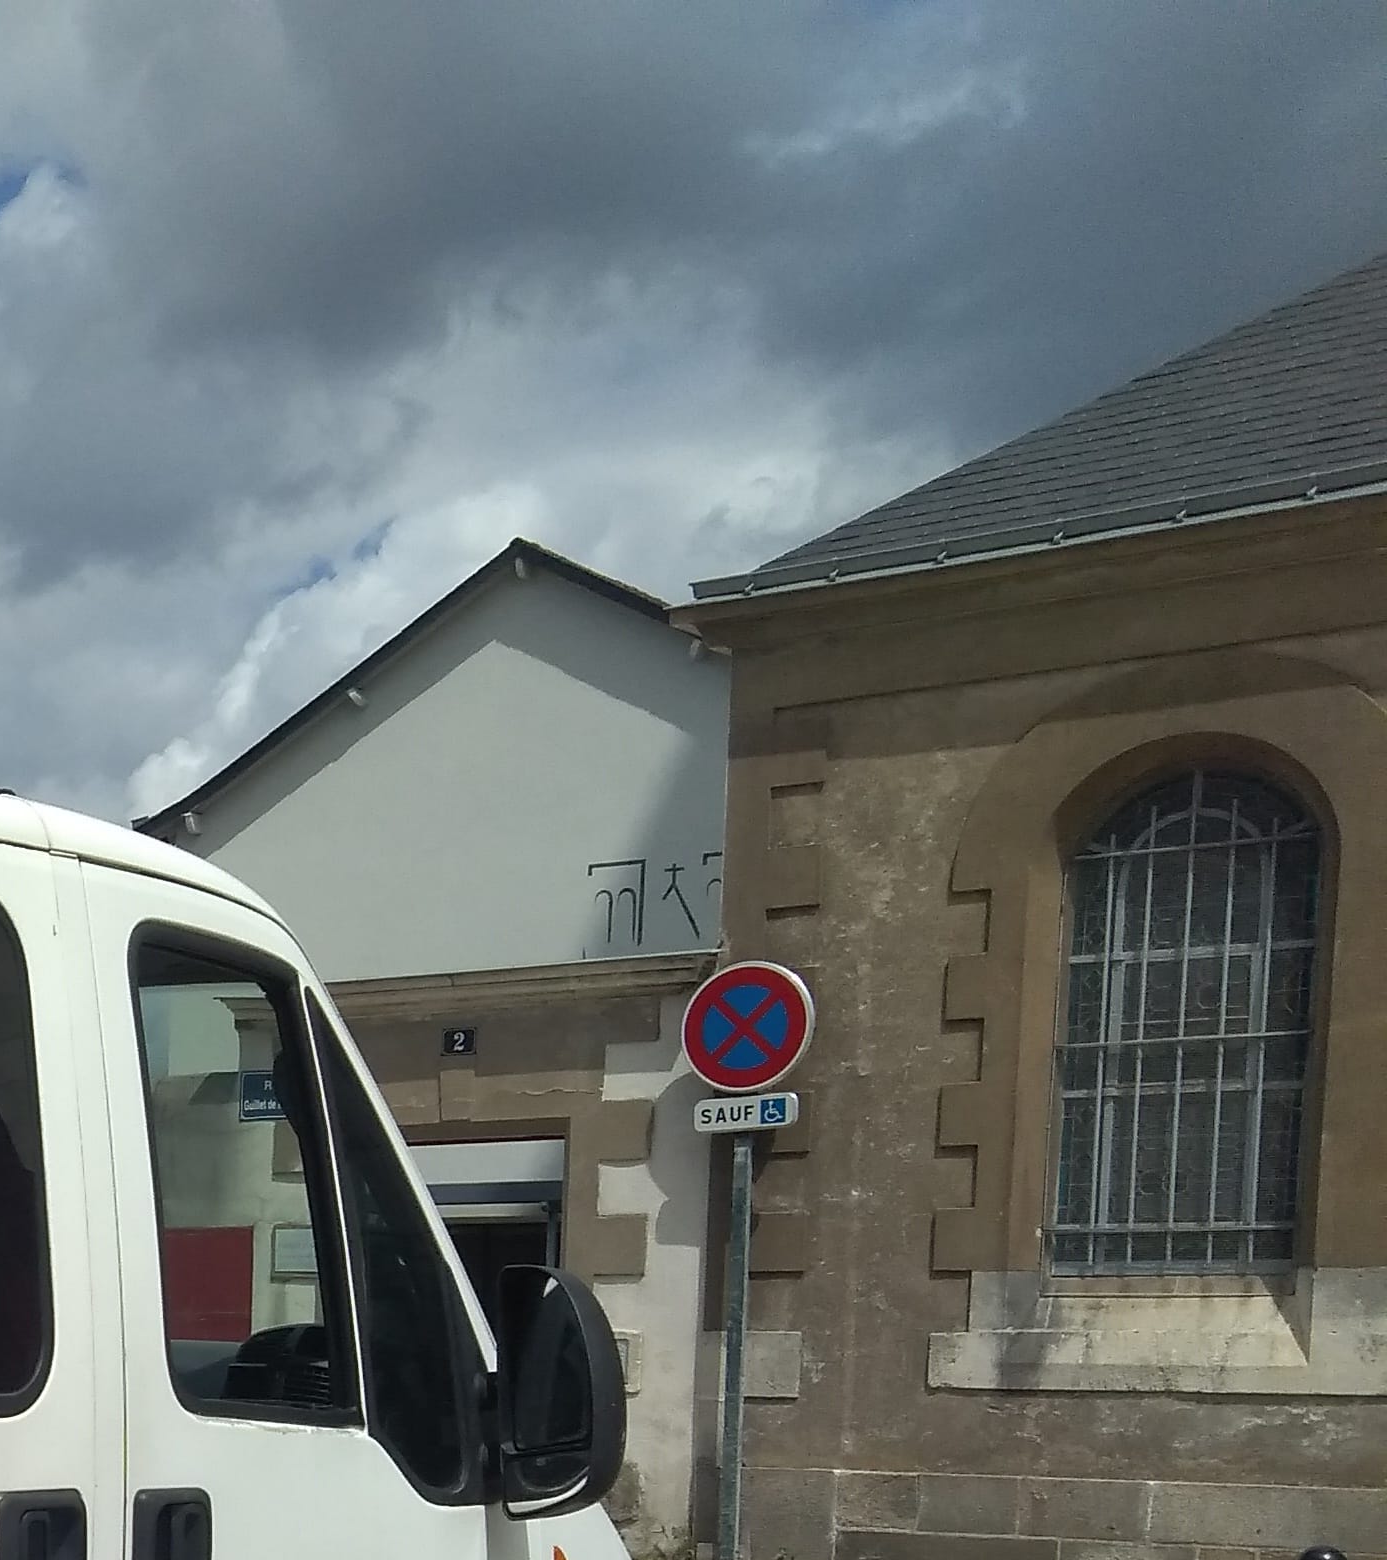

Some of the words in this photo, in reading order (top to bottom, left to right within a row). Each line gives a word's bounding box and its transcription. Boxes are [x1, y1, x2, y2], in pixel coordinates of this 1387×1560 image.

[453, 1031, 466, 1052] 2
[267, 1098, 277, 1110] de
[700, 1104, 755, 1125] SAUF
